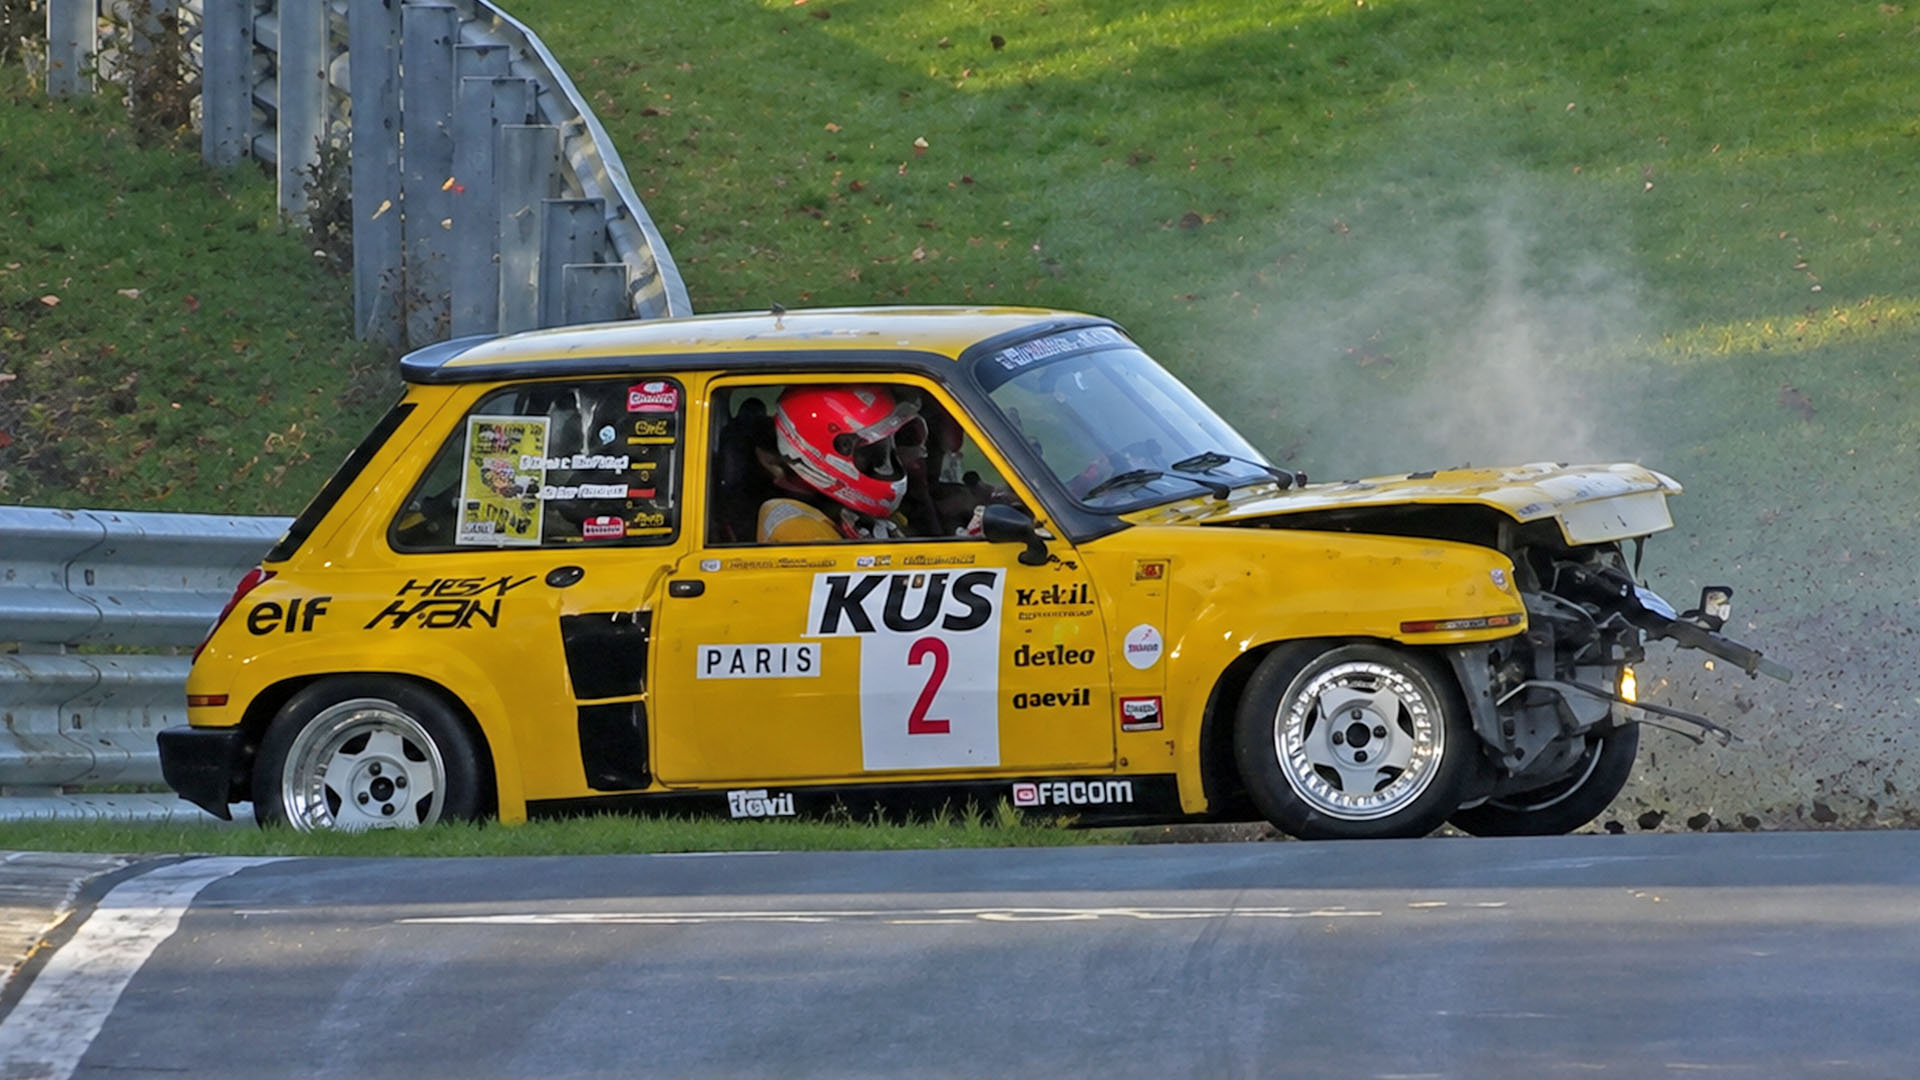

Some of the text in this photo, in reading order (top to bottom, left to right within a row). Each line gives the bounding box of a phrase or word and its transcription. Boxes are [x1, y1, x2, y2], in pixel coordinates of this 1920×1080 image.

[247, 597, 332, 635] elf
[706, 647, 812, 674] PARIS
[907, 636, 950, 735] 2
